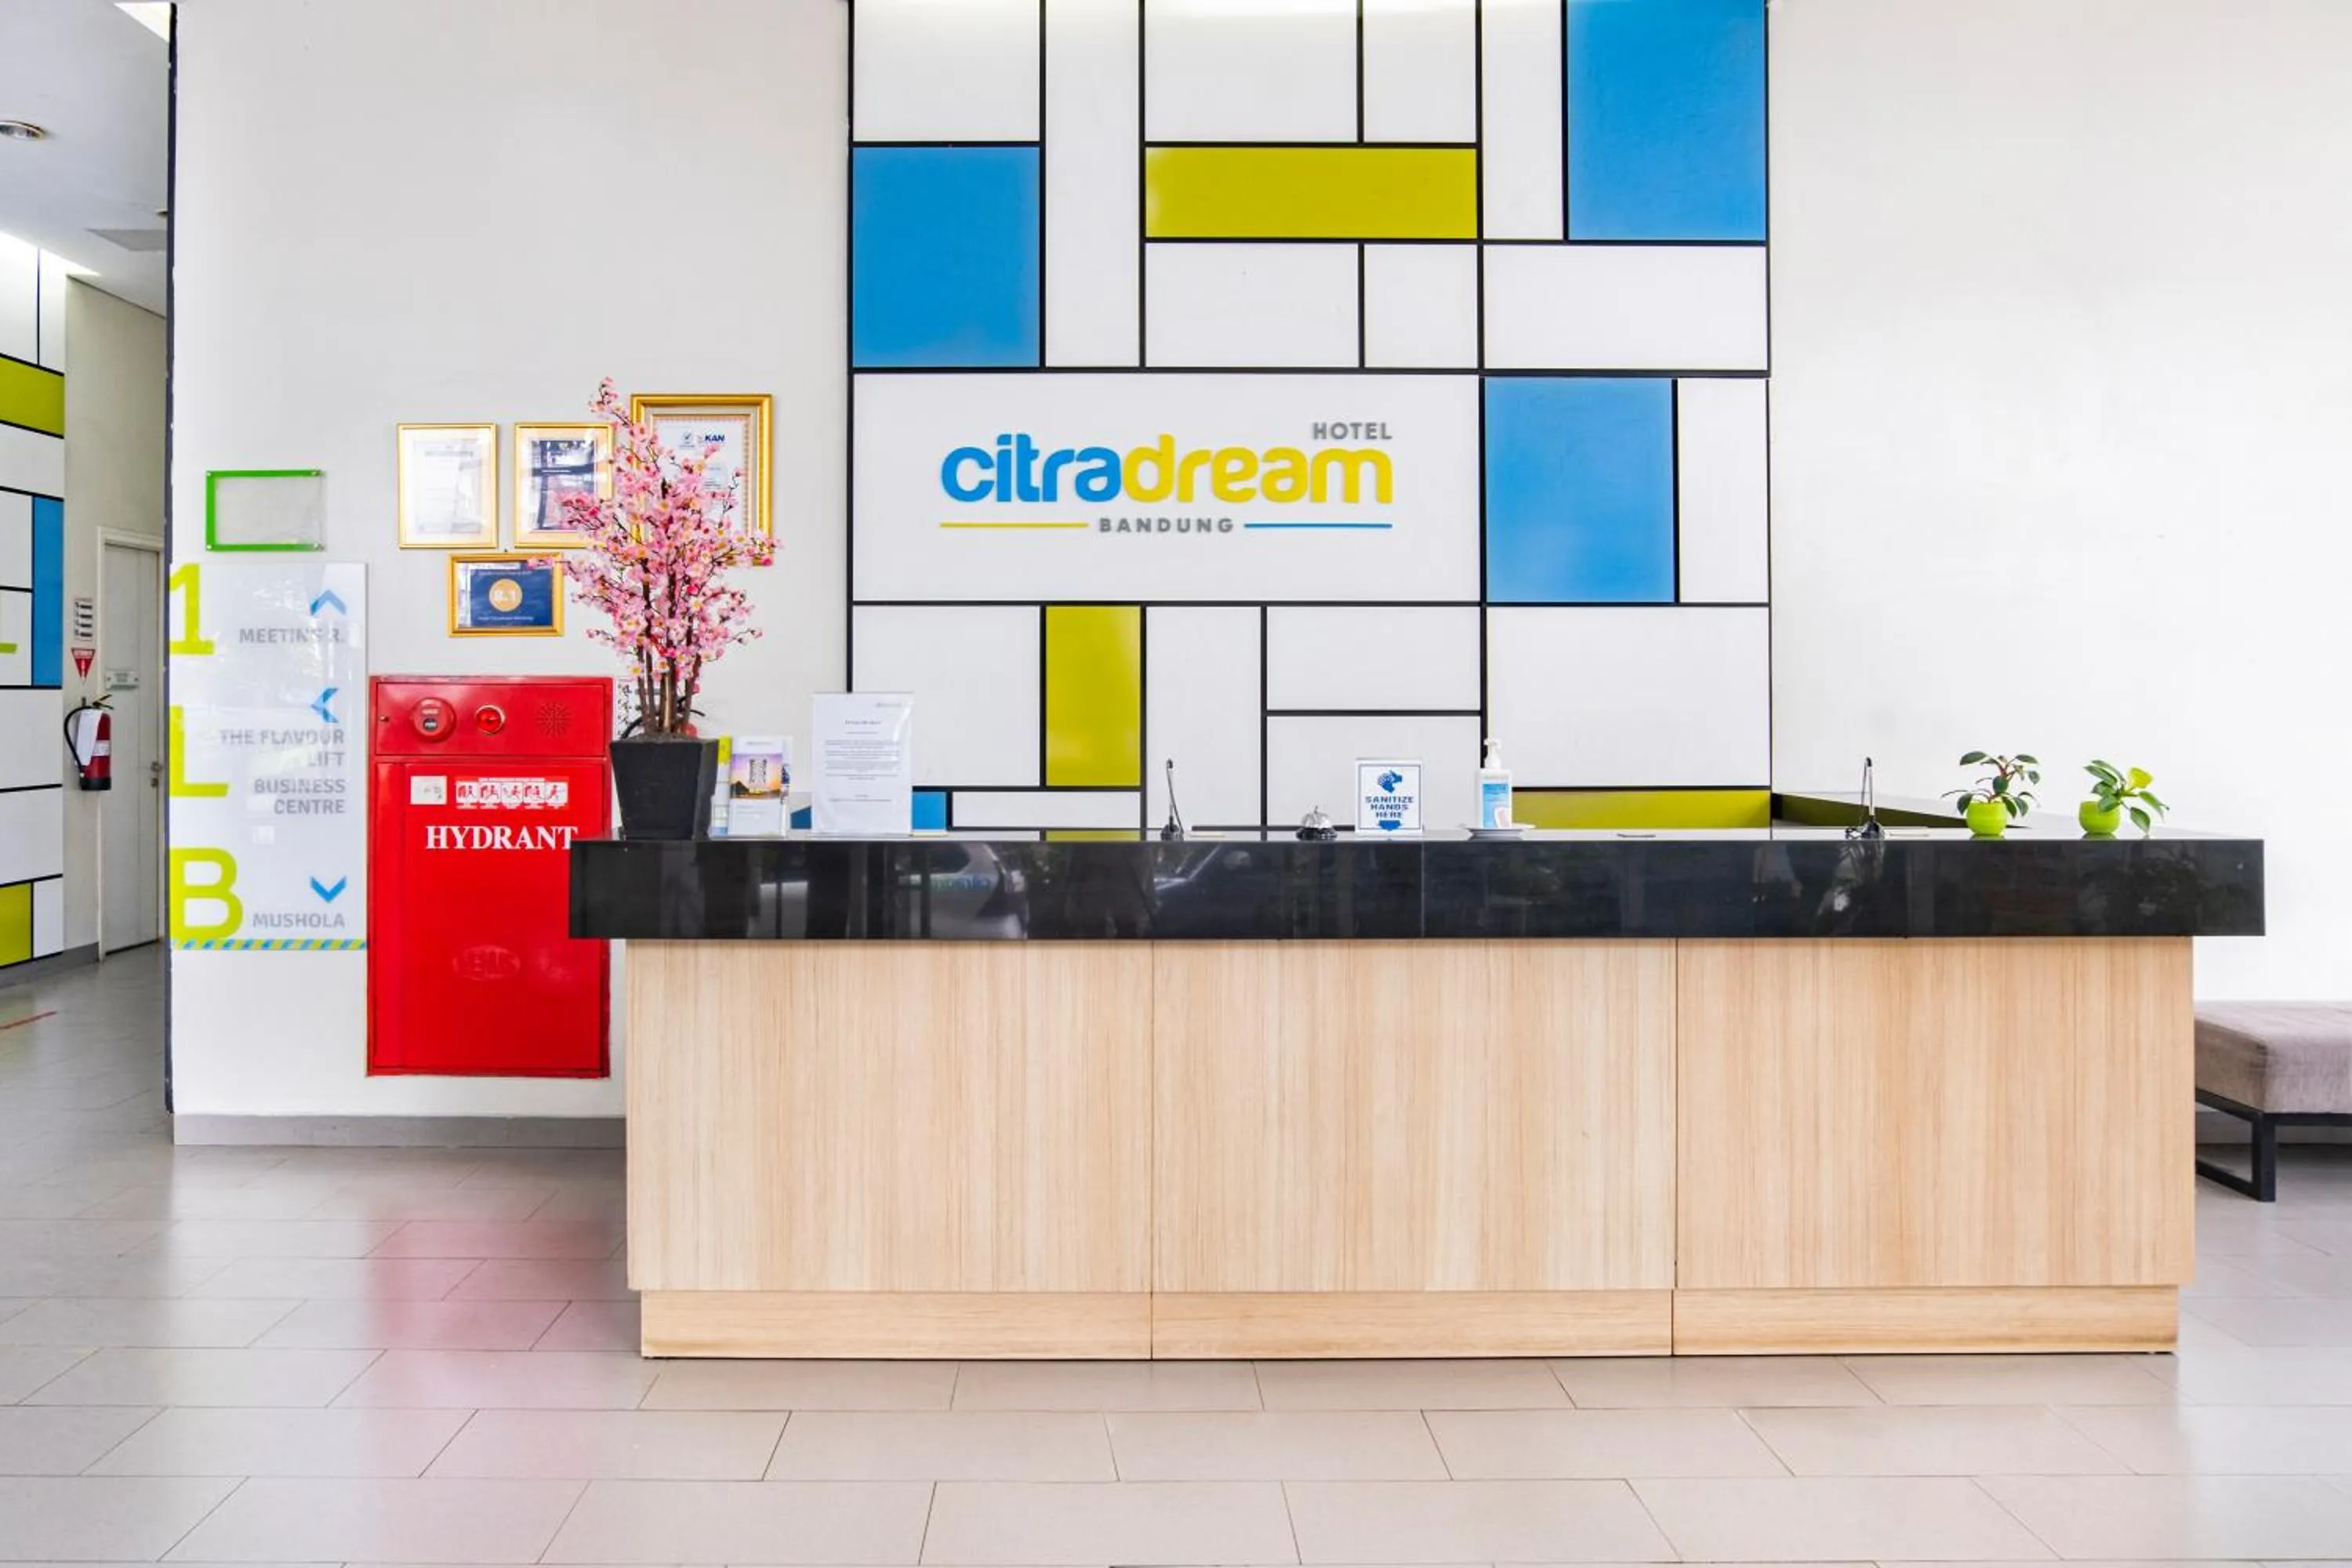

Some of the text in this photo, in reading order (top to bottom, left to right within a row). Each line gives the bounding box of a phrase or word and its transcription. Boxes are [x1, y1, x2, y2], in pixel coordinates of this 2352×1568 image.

[1312, 423, 1393, 439] HOTEL
[940, 433, 1393, 503] citradream
[1098, 517, 1235, 533] BANDUNG
[169, 563, 215, 655] 1
[220, 729, 345, 745] THE FLAVOUR
[169, 705, 229, 798] L
[308, 751, 345, 767] LIFT
[254, 779, 346, 794] BUSINESS
[274, 799, 346, 815] CENTRE
[426, 826, 578, 851] HYDRANT
[169, 848, 243, 940] B
[252, 913, 345, 928] MUSHOLA
